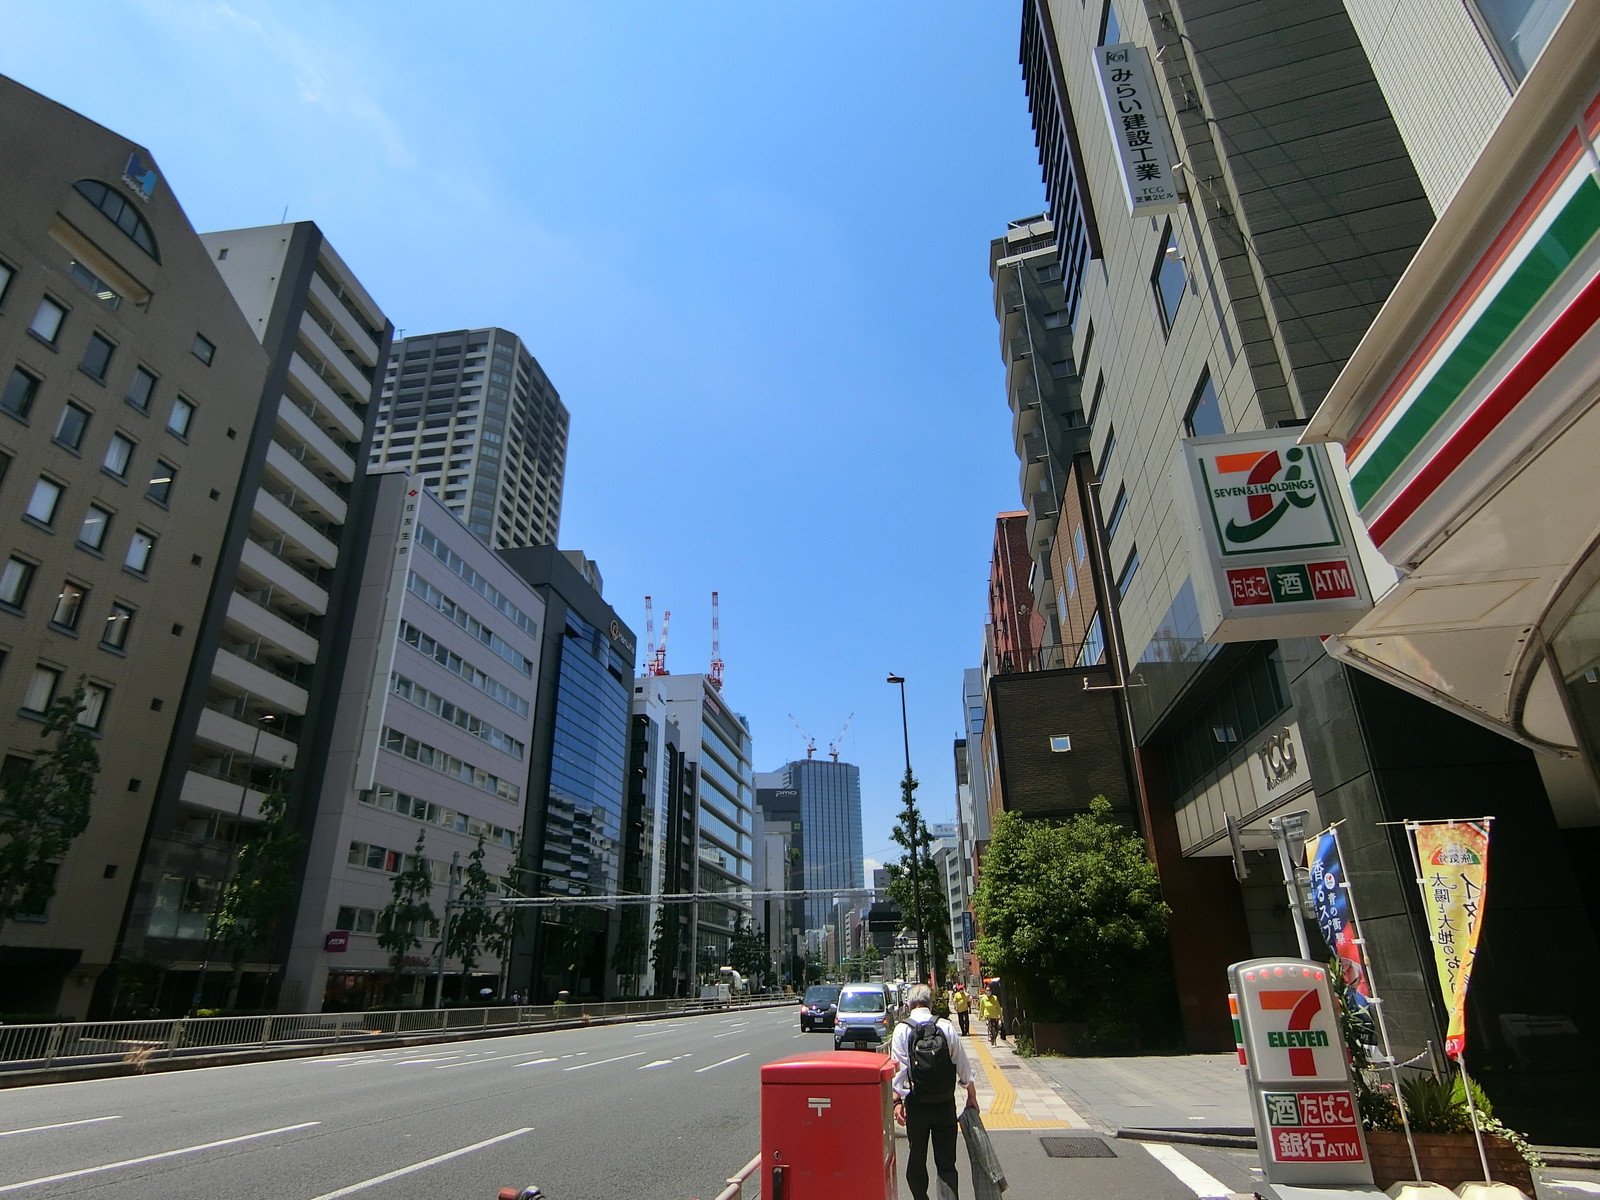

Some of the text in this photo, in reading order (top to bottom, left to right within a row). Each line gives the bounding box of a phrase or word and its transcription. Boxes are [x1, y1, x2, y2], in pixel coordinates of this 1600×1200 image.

[1111, 68, 1161, 182] みらい建設工業
[1141, 186, 1165, 195] TCG
[1260, 479, 1315, 494] HOLDINGS
[1230, 576, 1270, 599] たばこ
[1277, 572, 1304, 596] 酒
[1314, 568, 1351, 592] ATM
[1268, 1096, 1298, 1125] 酒
[1301, 1096, 1354, 1124] たばこ
[1278, 1132, 1359, 1158] 銀行ATM
